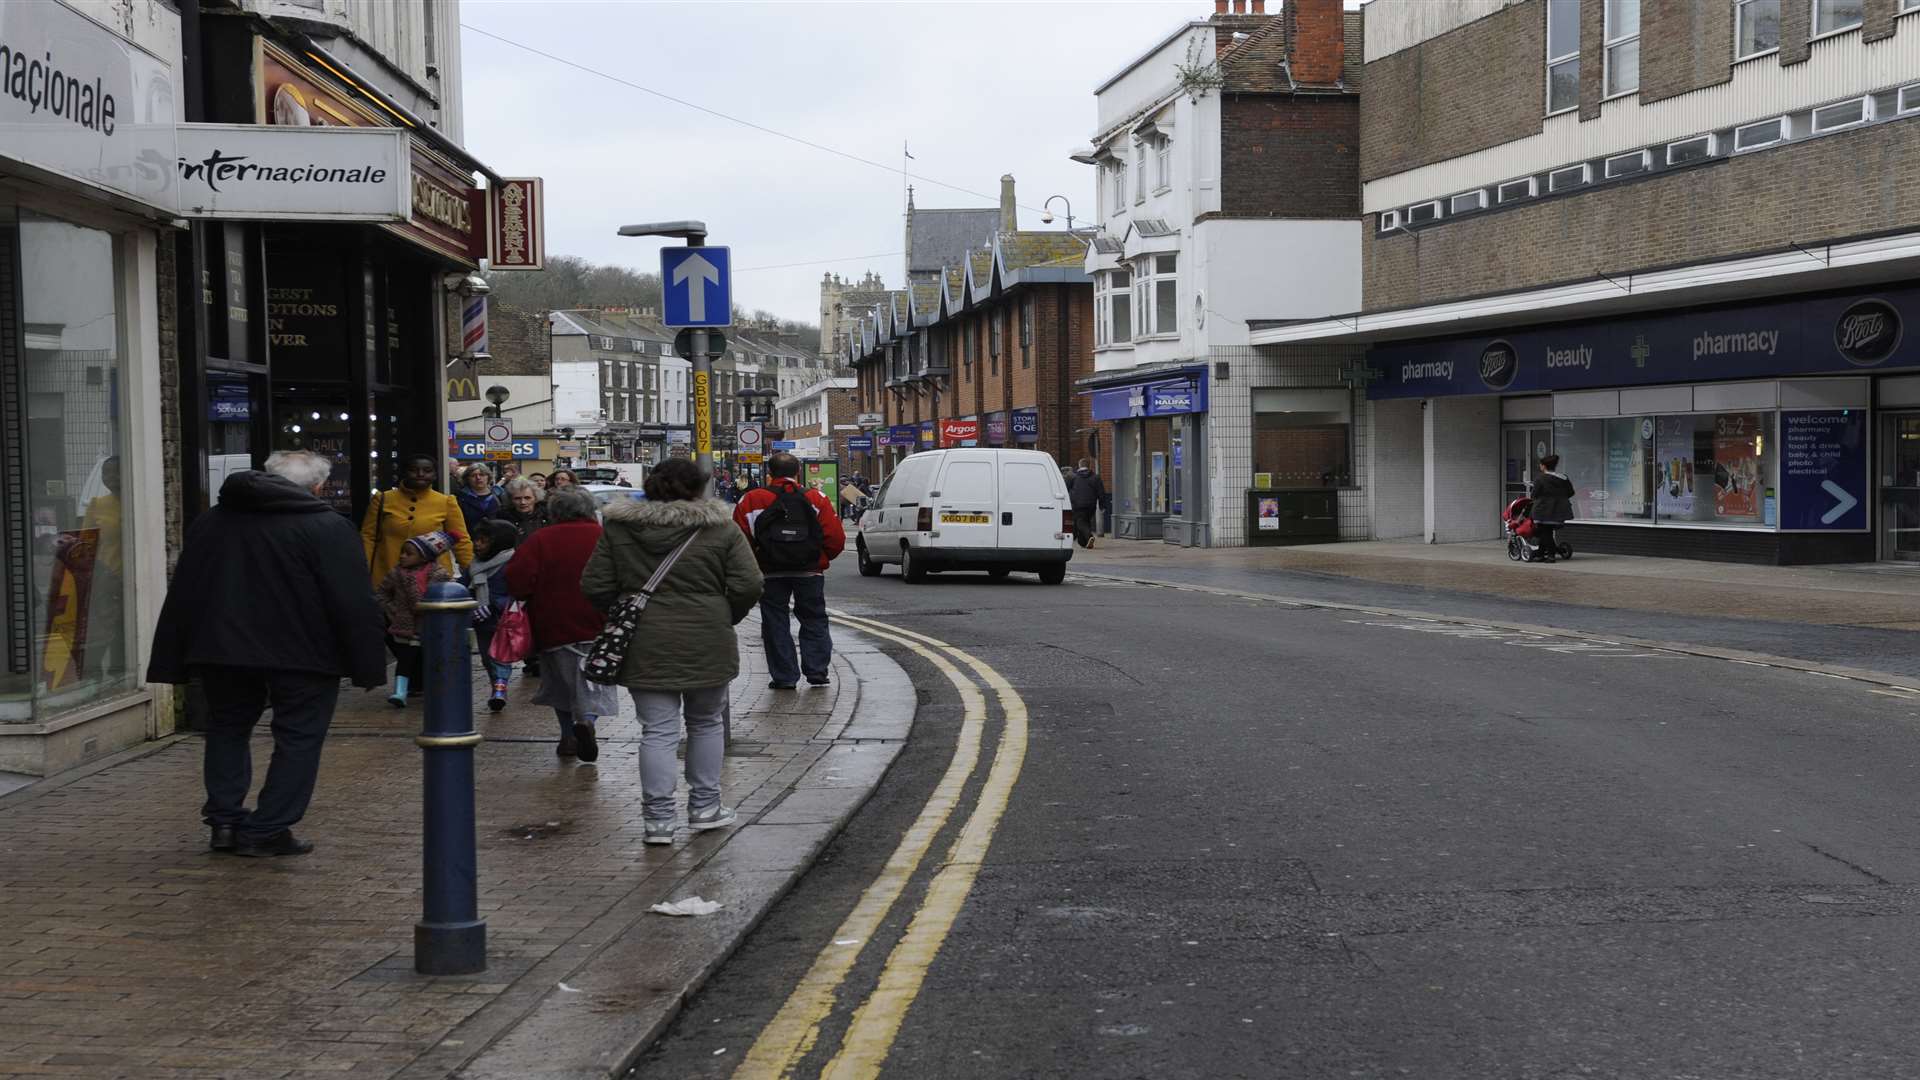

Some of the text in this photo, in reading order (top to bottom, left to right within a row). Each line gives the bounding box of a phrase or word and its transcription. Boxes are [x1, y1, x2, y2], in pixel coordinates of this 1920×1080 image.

[178, 149, 386, 193] internaçionale
[1693, 330, 1779, 361] pharmacy
[1547, 344, 1593, 370] beauty
[1402, 360, 1454, 383] pharmacy
[1013, 424, 1037, 432] ONE
[1788, 415, 1848, 424] welcome
[945, 425, 977, 434] Argos
[463, 443, 534, 455] GRGS
